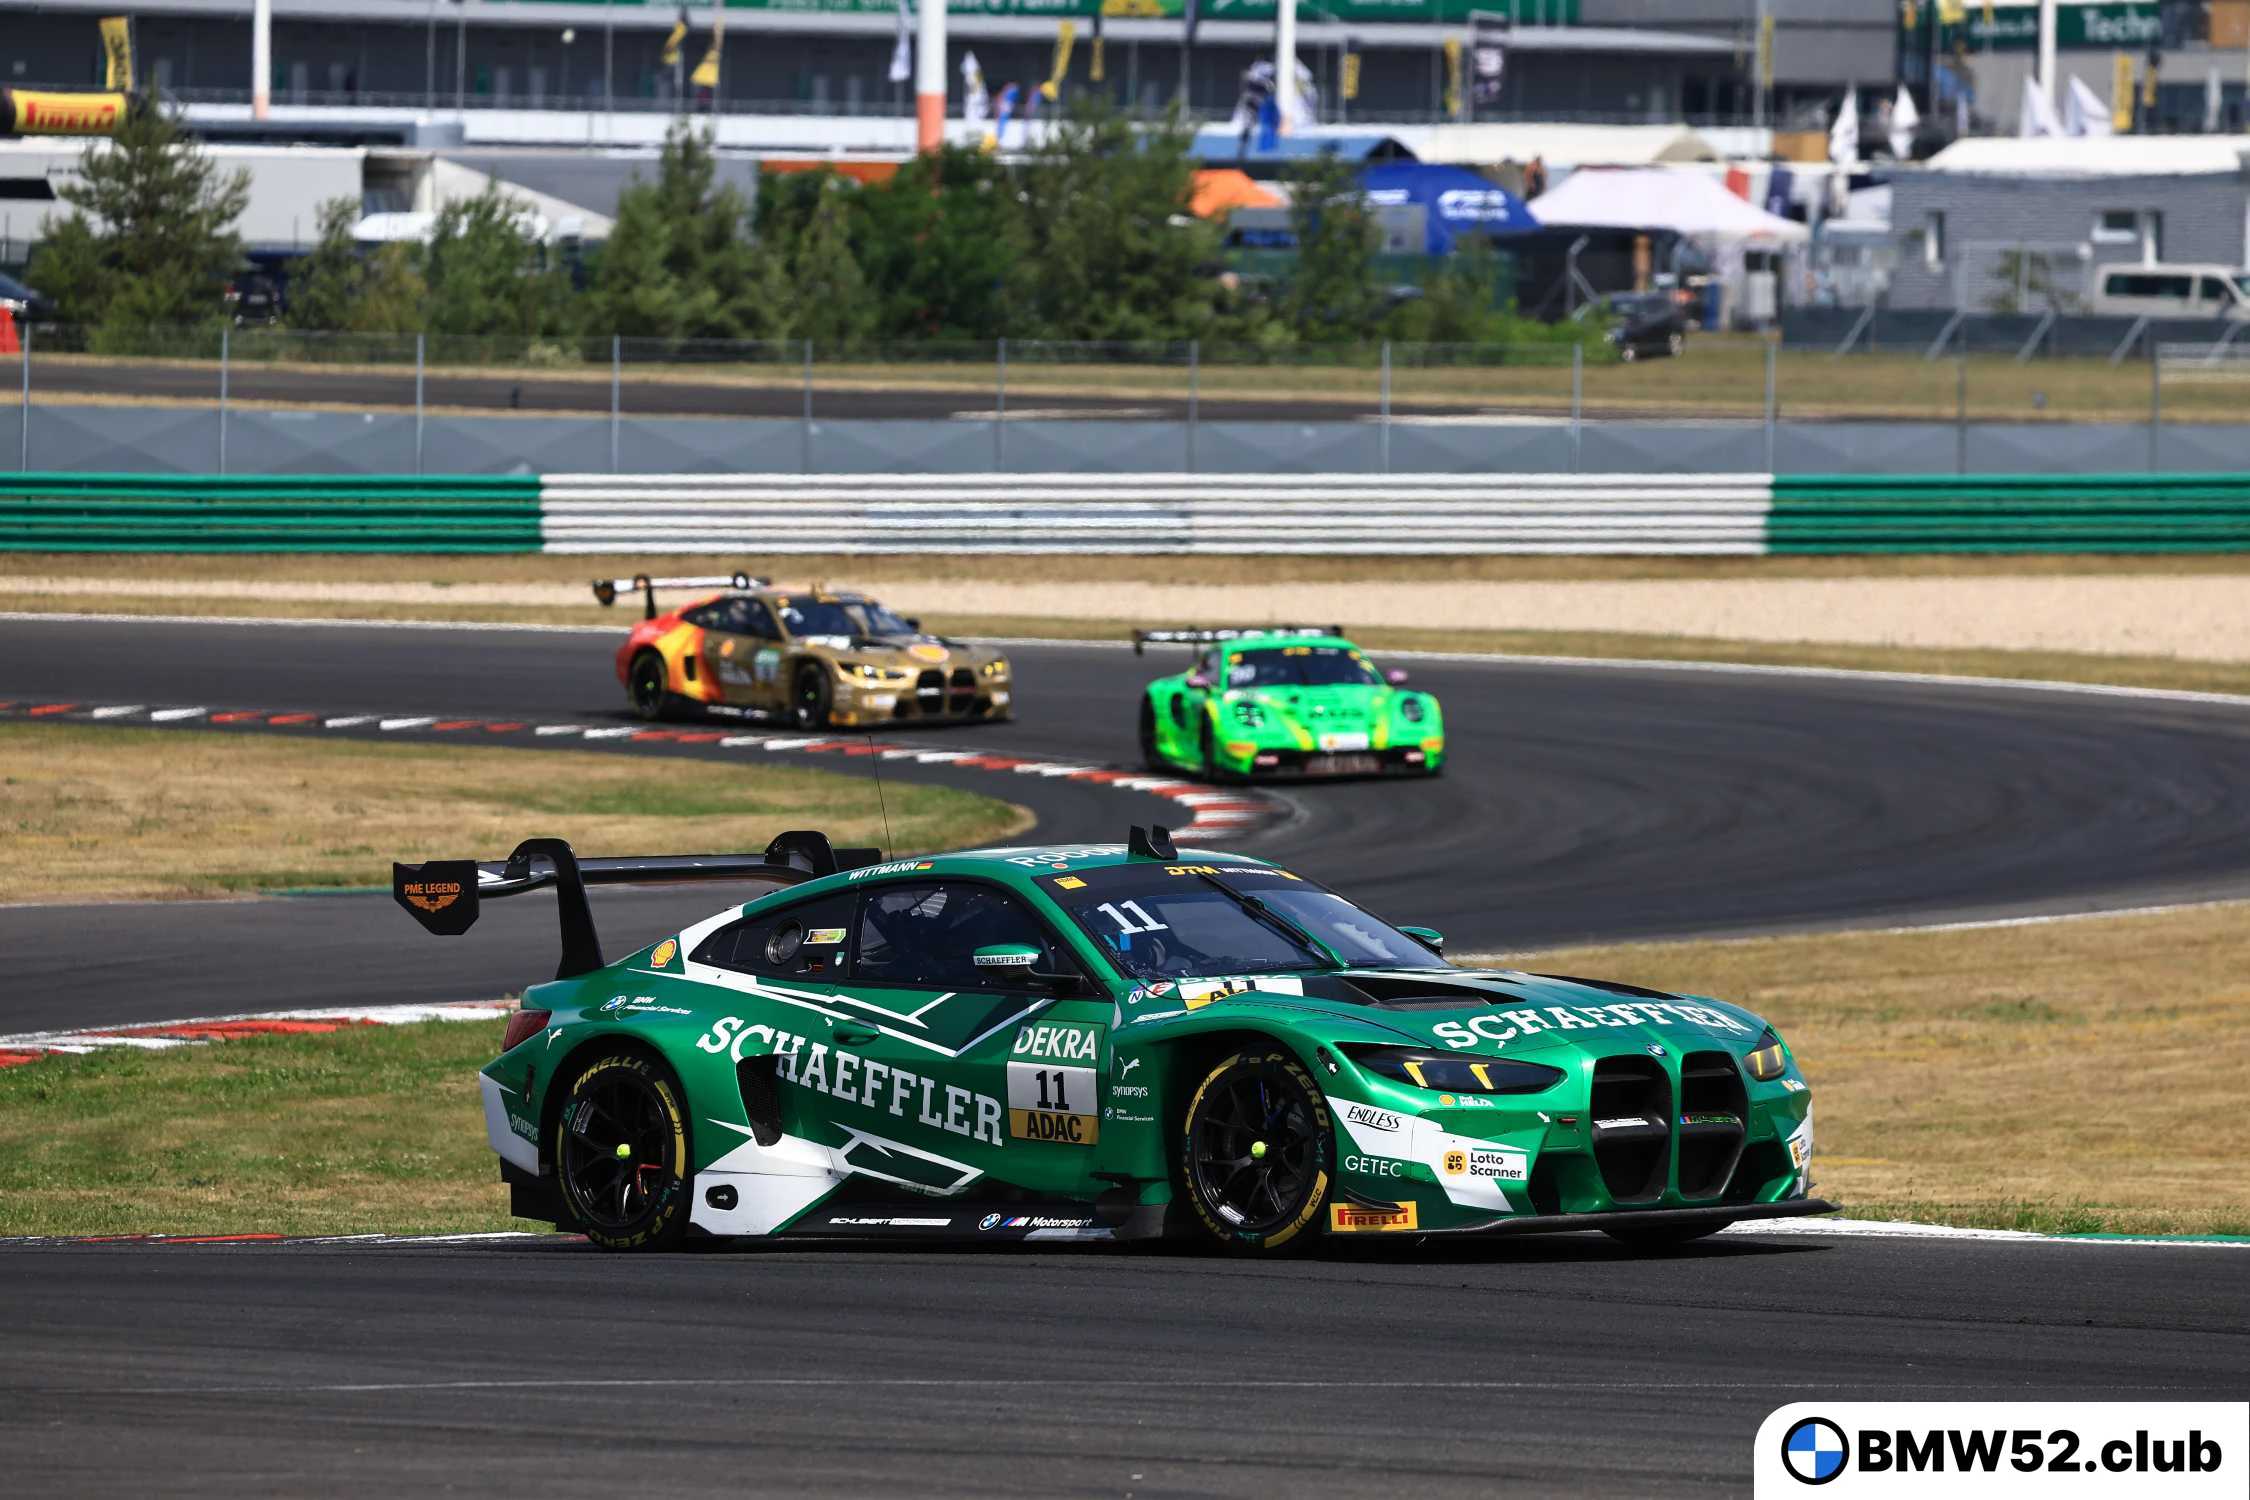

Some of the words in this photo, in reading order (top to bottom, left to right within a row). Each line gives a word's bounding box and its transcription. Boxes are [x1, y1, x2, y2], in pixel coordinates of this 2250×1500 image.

[849, 861, 919, 880] WITTMANN
[404, 883, 424, 894] PME
[425, 882, 461, 894] LEGEND
[1097, 900, 1168, 934] 11
[976, 956, 1026, 964] SCHAEFFLER
[1432, 1002, 1752, 1048] SCHAEFFLER
[1013, 1026, 1097, 1060] DEKRA
[573, 1056, 643, 1096] PIRELLI
[696, 1016, 1003, 1147] SCHAEFFLER
[1035, 1070, 1070, 1110] 11
[1027, 1111, 1082, 1142] ADAC
[1347, 1105, 1402, 1129] ENDLESS
[1345, 1155, 1403, 1178] GETEC
[1470, 1151, 1504, 1165] Lotto
[1470, 1165, 1522, 1178] Scanner
[1030, 1217, 1093, 1228] Motorsport
[1337, 1207, 1408, 1226] PIRELLI
